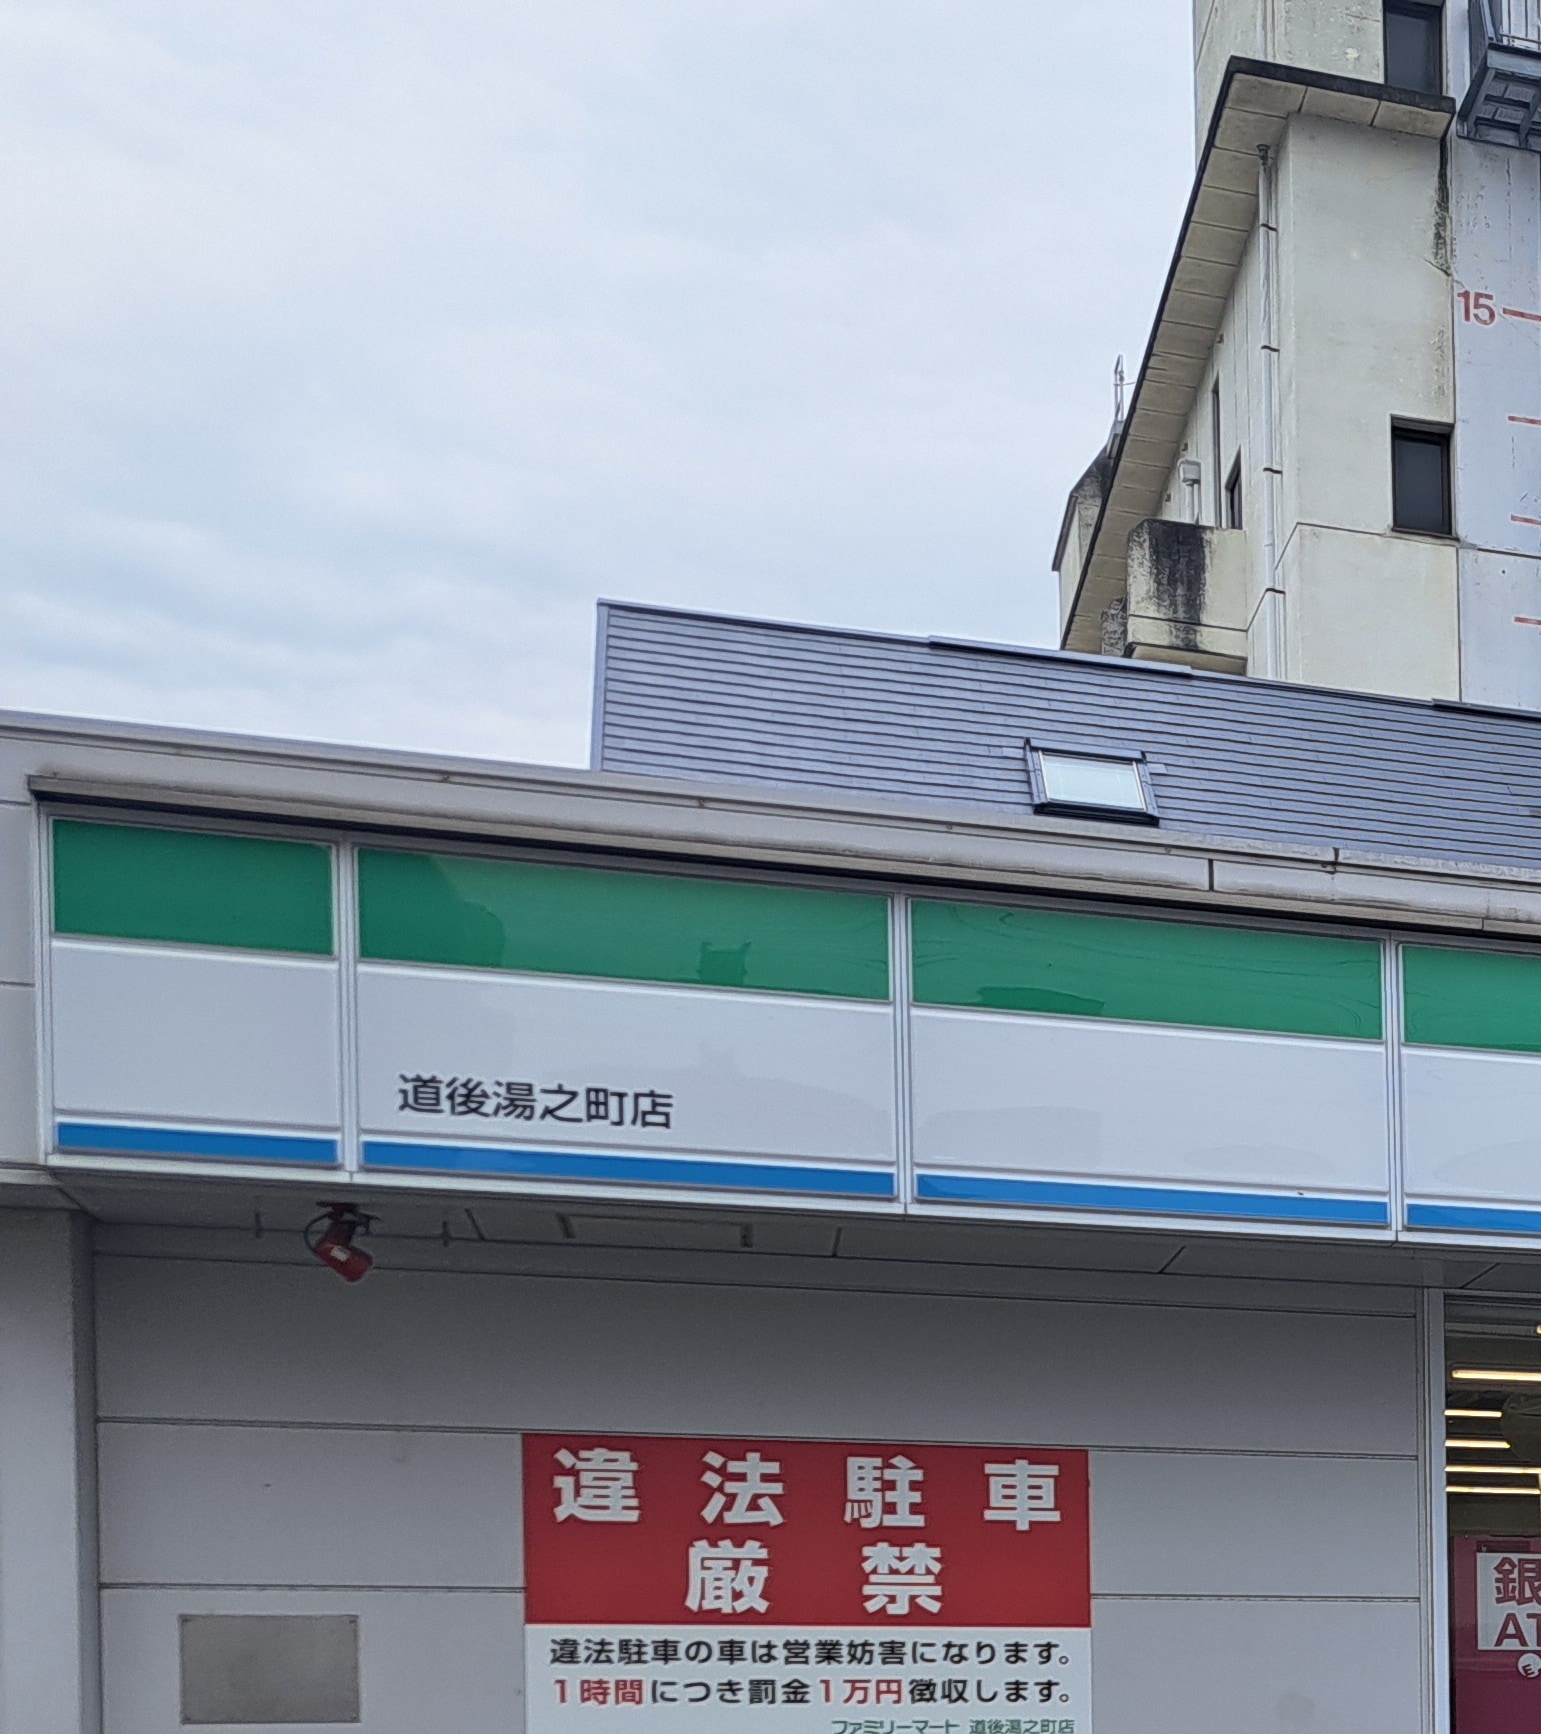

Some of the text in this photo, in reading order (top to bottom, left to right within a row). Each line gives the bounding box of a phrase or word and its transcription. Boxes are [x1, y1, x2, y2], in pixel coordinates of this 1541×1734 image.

[1457, 289, 1496, 326] 15
[398, 1074, 675, 1131] 道後湯之町店
[552, 1447, 1062, 1532] 違法駐車
[684, 1539, 943, 1615] 厳禁
[549, 1637, 1072, 1667] 違法駐車の車は営業妨害になります。
[553, 1678, 1072, 1705] 1時間につき罰金1万円徴収します。
